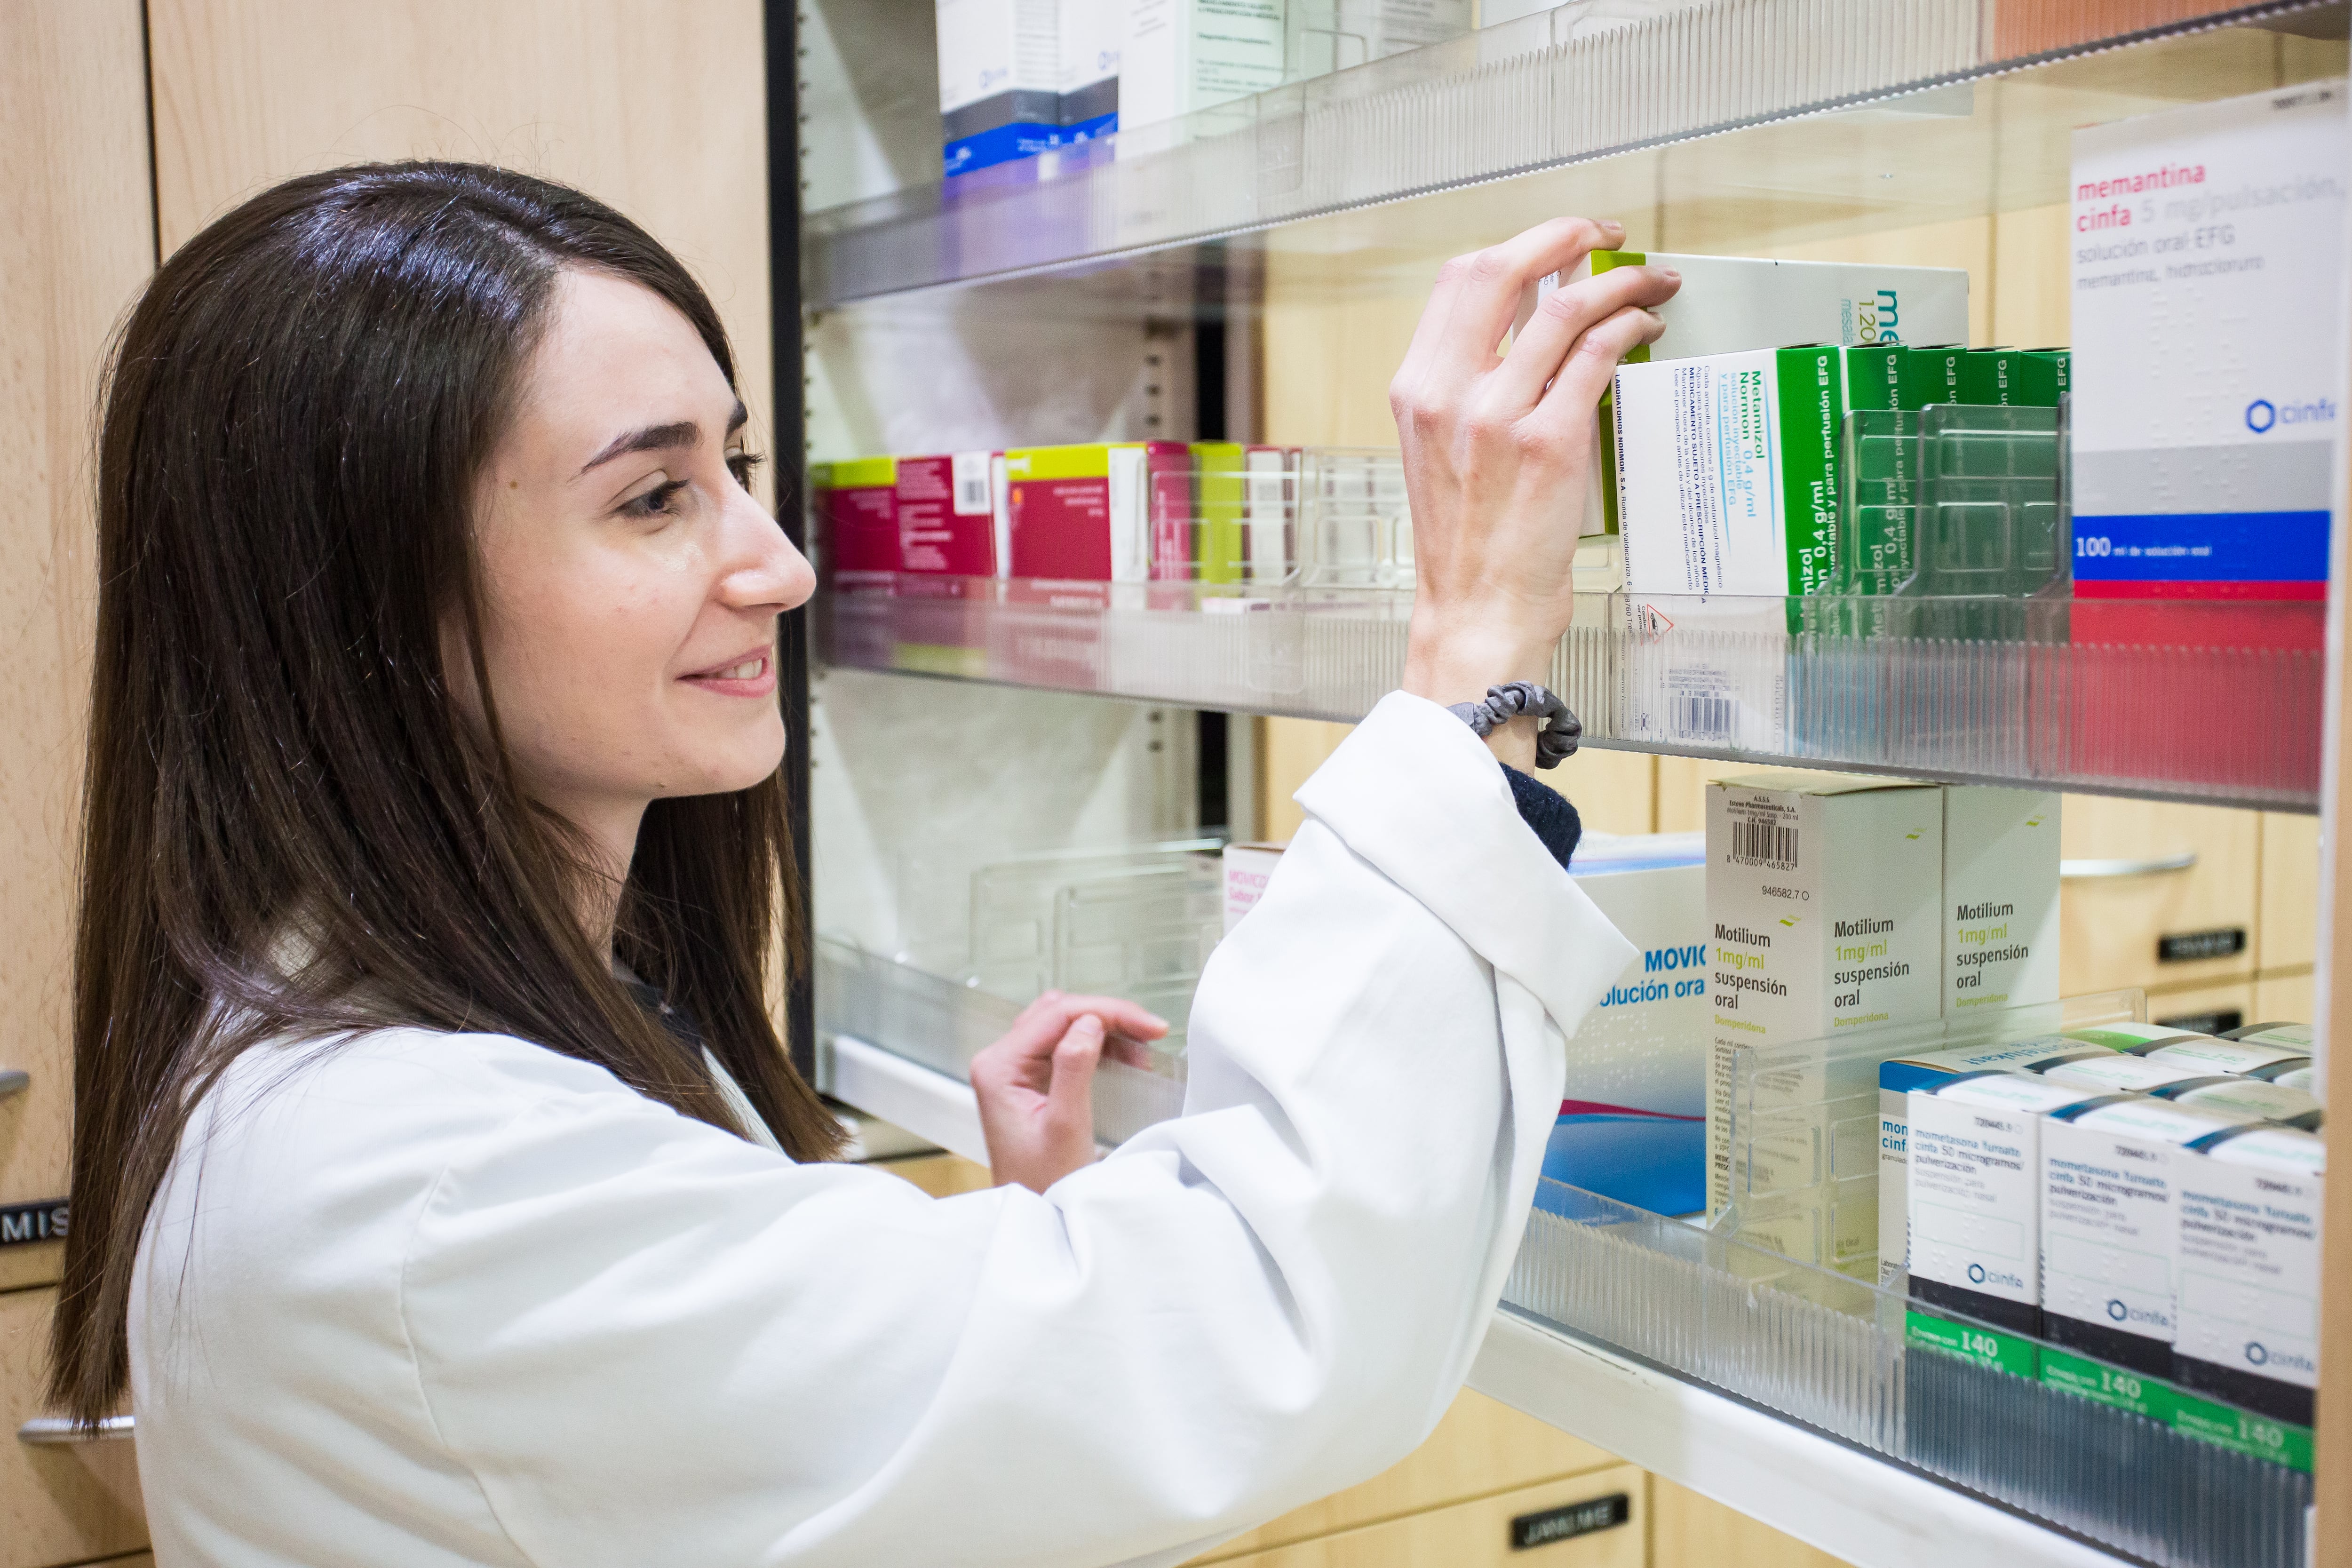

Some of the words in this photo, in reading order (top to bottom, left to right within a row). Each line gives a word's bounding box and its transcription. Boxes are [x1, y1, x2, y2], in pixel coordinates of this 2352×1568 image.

[2077, 163, 2206, 201] memantina
[2077, 204, 2132, 232] cinfa
[2141, 199, 2155, 223] 5
[2077, 238, 2148, 264] solución
[2153, 231, 2189, 254] oral
[2195, 225, 2236, 248] EFG
[1817, 356, 1828, 385] EFG
[1887, 354, 1898, 383] EFG
[1946, 357, 1956, 385] EFG
[1998, 360, 2008, 388] EFG
[2058, 358, 2066, 386] EFG
[1721, 384, 1730, 412] para
[1731, 373, 1740, 423] solución
[1740, 372, 1750, 439] Normon
[1752, 371, 1765, 458] Metamizol
[1819, 390, 1834, 458] perfusión
[1697, 413, 1706, 473] preparaciones
[1722, 416, 1734, 475] perfusión
[1732, 428, 1744, 489] inyectable
[1743, 450, 1754, 474] 0,4
[1683, 435, 1689, 445] de
[1691, 537, 1697, 548] de
[1824, 463, 1836, 494] para
[1701, 477, 1709, 524] inyectables
[1743, 480, 1756, 517] g/ml
[1810, 481, 1827, 523] g/ml
[1623, 522, 1628, 530] de
[1678, 471, 1684, 481] de
[1683, 533, 1693, 589] medicamento
[1695, 493, 1707, 564] PRESCRIPCIÓN
[1709, 483, 1715, 493] de
[1714, 542, 1723, 588] magnésico
[1813, 529, 1829, 557] 0,4
[2076, 537, 2111, 557] 100
[1745, 801, 1785, 813] Pharmaceuticals,
[1736, 857, 1763, 867] 470009
[1767, 860, 1795, 871] 465827
[1762, 885, 1799, 899] 946582.7
[1957, 902, 2013, 921] Motilium
[1715, 923, 1770, 947] Motilium
[1834, 918, 1893, 938] Motilium
[1958, 923, 2007, 945] 1mg/ml
[1716, 947, 1764, 970] 1mg/ml
[1836, 939, 1888, 963] 1mg/ml
[1957, 944, 2028, 967] suspensión
[1715, 972, 1787, 996] suspensión
[1834, 962, 1909, 986] suspensión
[1957, 971, 1981, 988] oral
[1715, 994, 1738, 1010] oral
[1834, 988, 1859, 1008] oral
[1956, 993, 2009, 1008] Domperidona
[1715, 1014, 1766, 1034] Domperidona
[1834, 1012, 1889, 1027] Domperidona
[1883, 1121, 1908, 1136] mon
[1882, 1135, 1908, 1152] cinf
[1987, 1271, 2023, 1289] cinfa
[1961, 1331, 1998, 1357] 140
[2101, 1371, 2142, 1399] 140
[2239, 1418, 2284, 1448] 140
